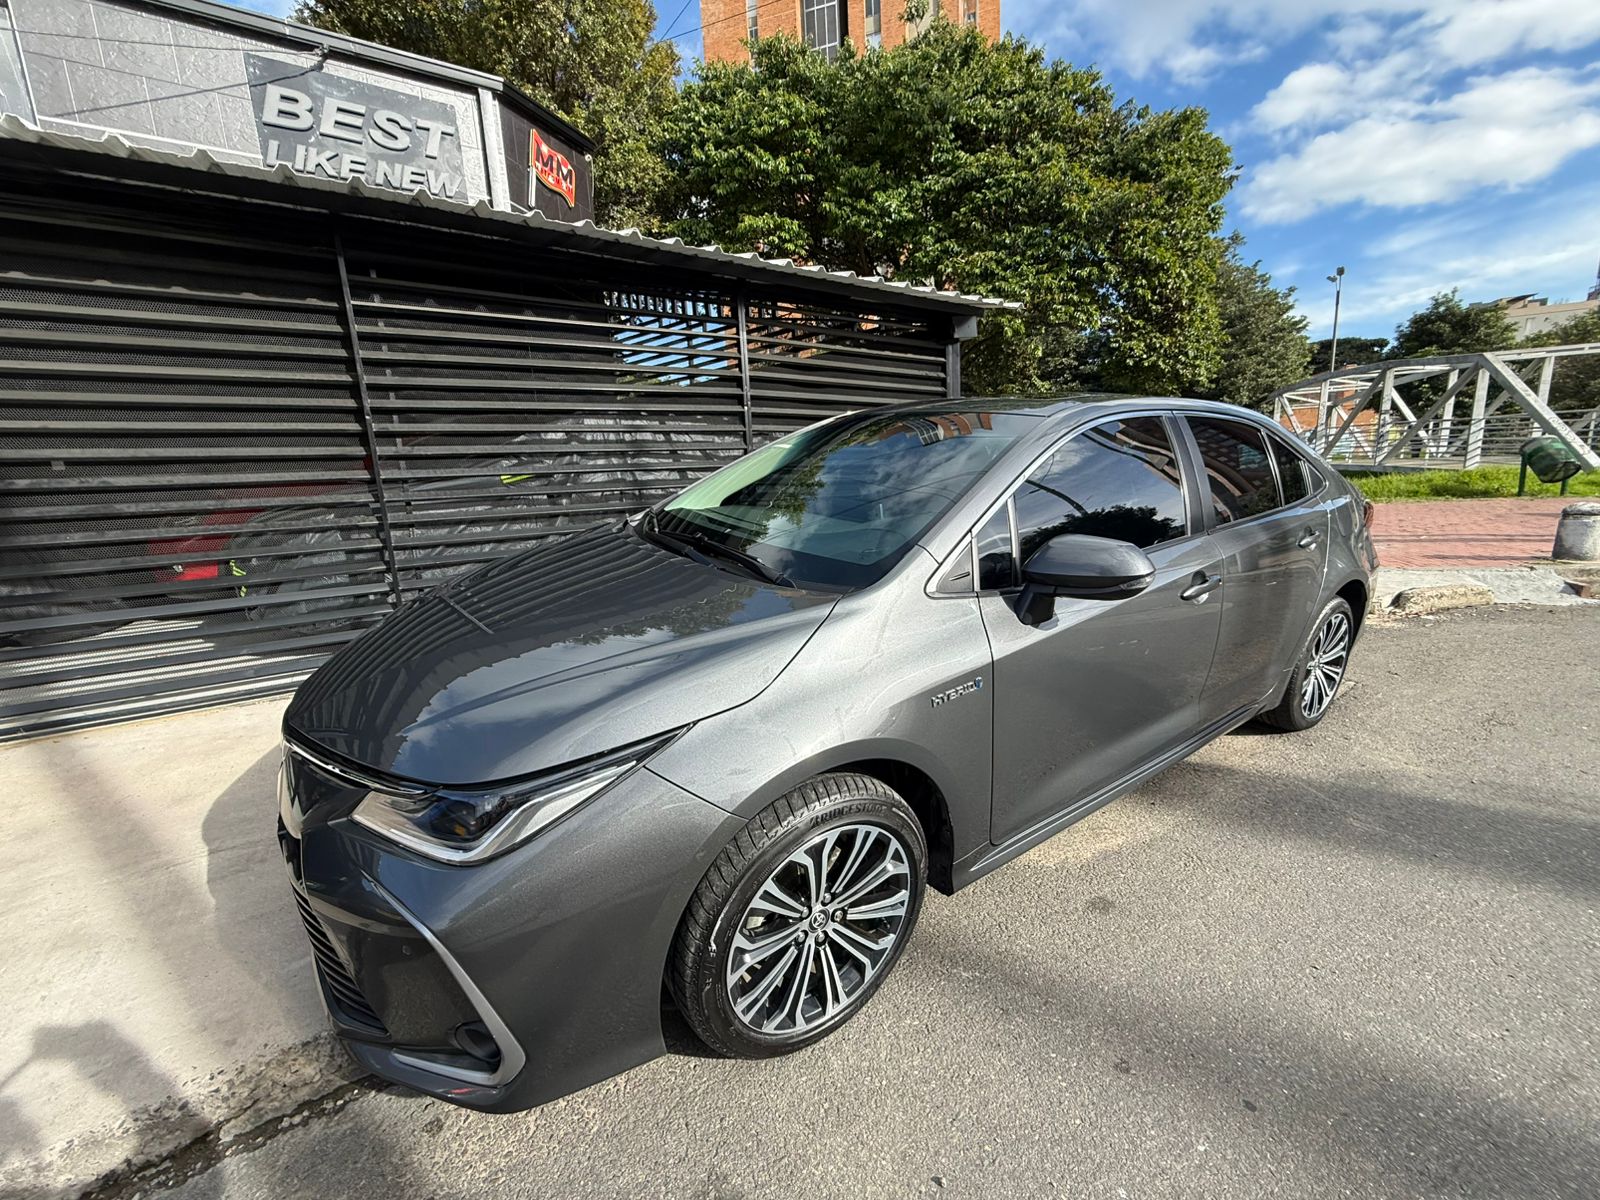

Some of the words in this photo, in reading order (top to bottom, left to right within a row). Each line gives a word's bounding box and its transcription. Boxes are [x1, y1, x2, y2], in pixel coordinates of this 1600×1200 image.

[262, 83, 455, 159] BEST
[266, 139, 367, 180] LIKE
[375, 160, 462, 198] NEW
[931, 681, 977, 708] HYBRID
